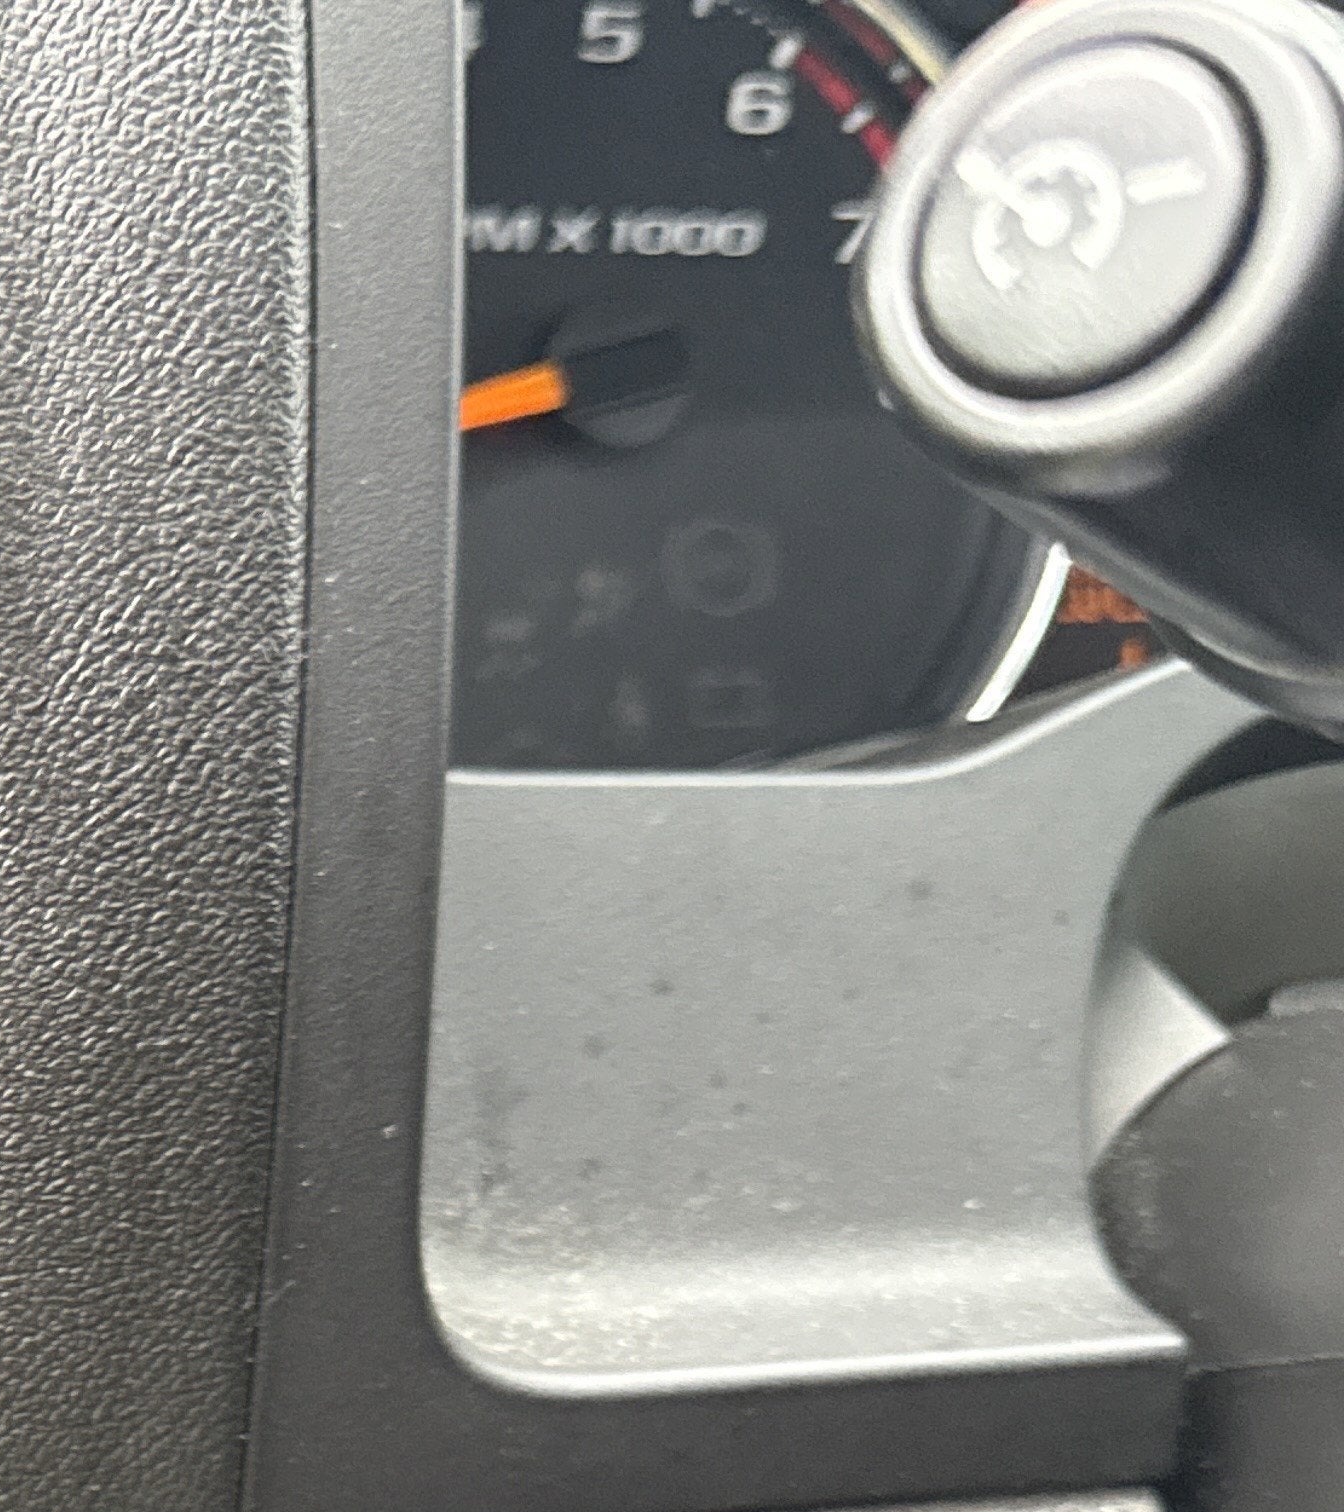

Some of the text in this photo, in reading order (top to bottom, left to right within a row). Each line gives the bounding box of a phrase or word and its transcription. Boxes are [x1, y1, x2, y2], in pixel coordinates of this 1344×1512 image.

[576, 6, 640, 64] 5
[725, 70, 793, 135] 6
[610, 206, 766, 257] 1000
[831, 203, 876, 265] 7
